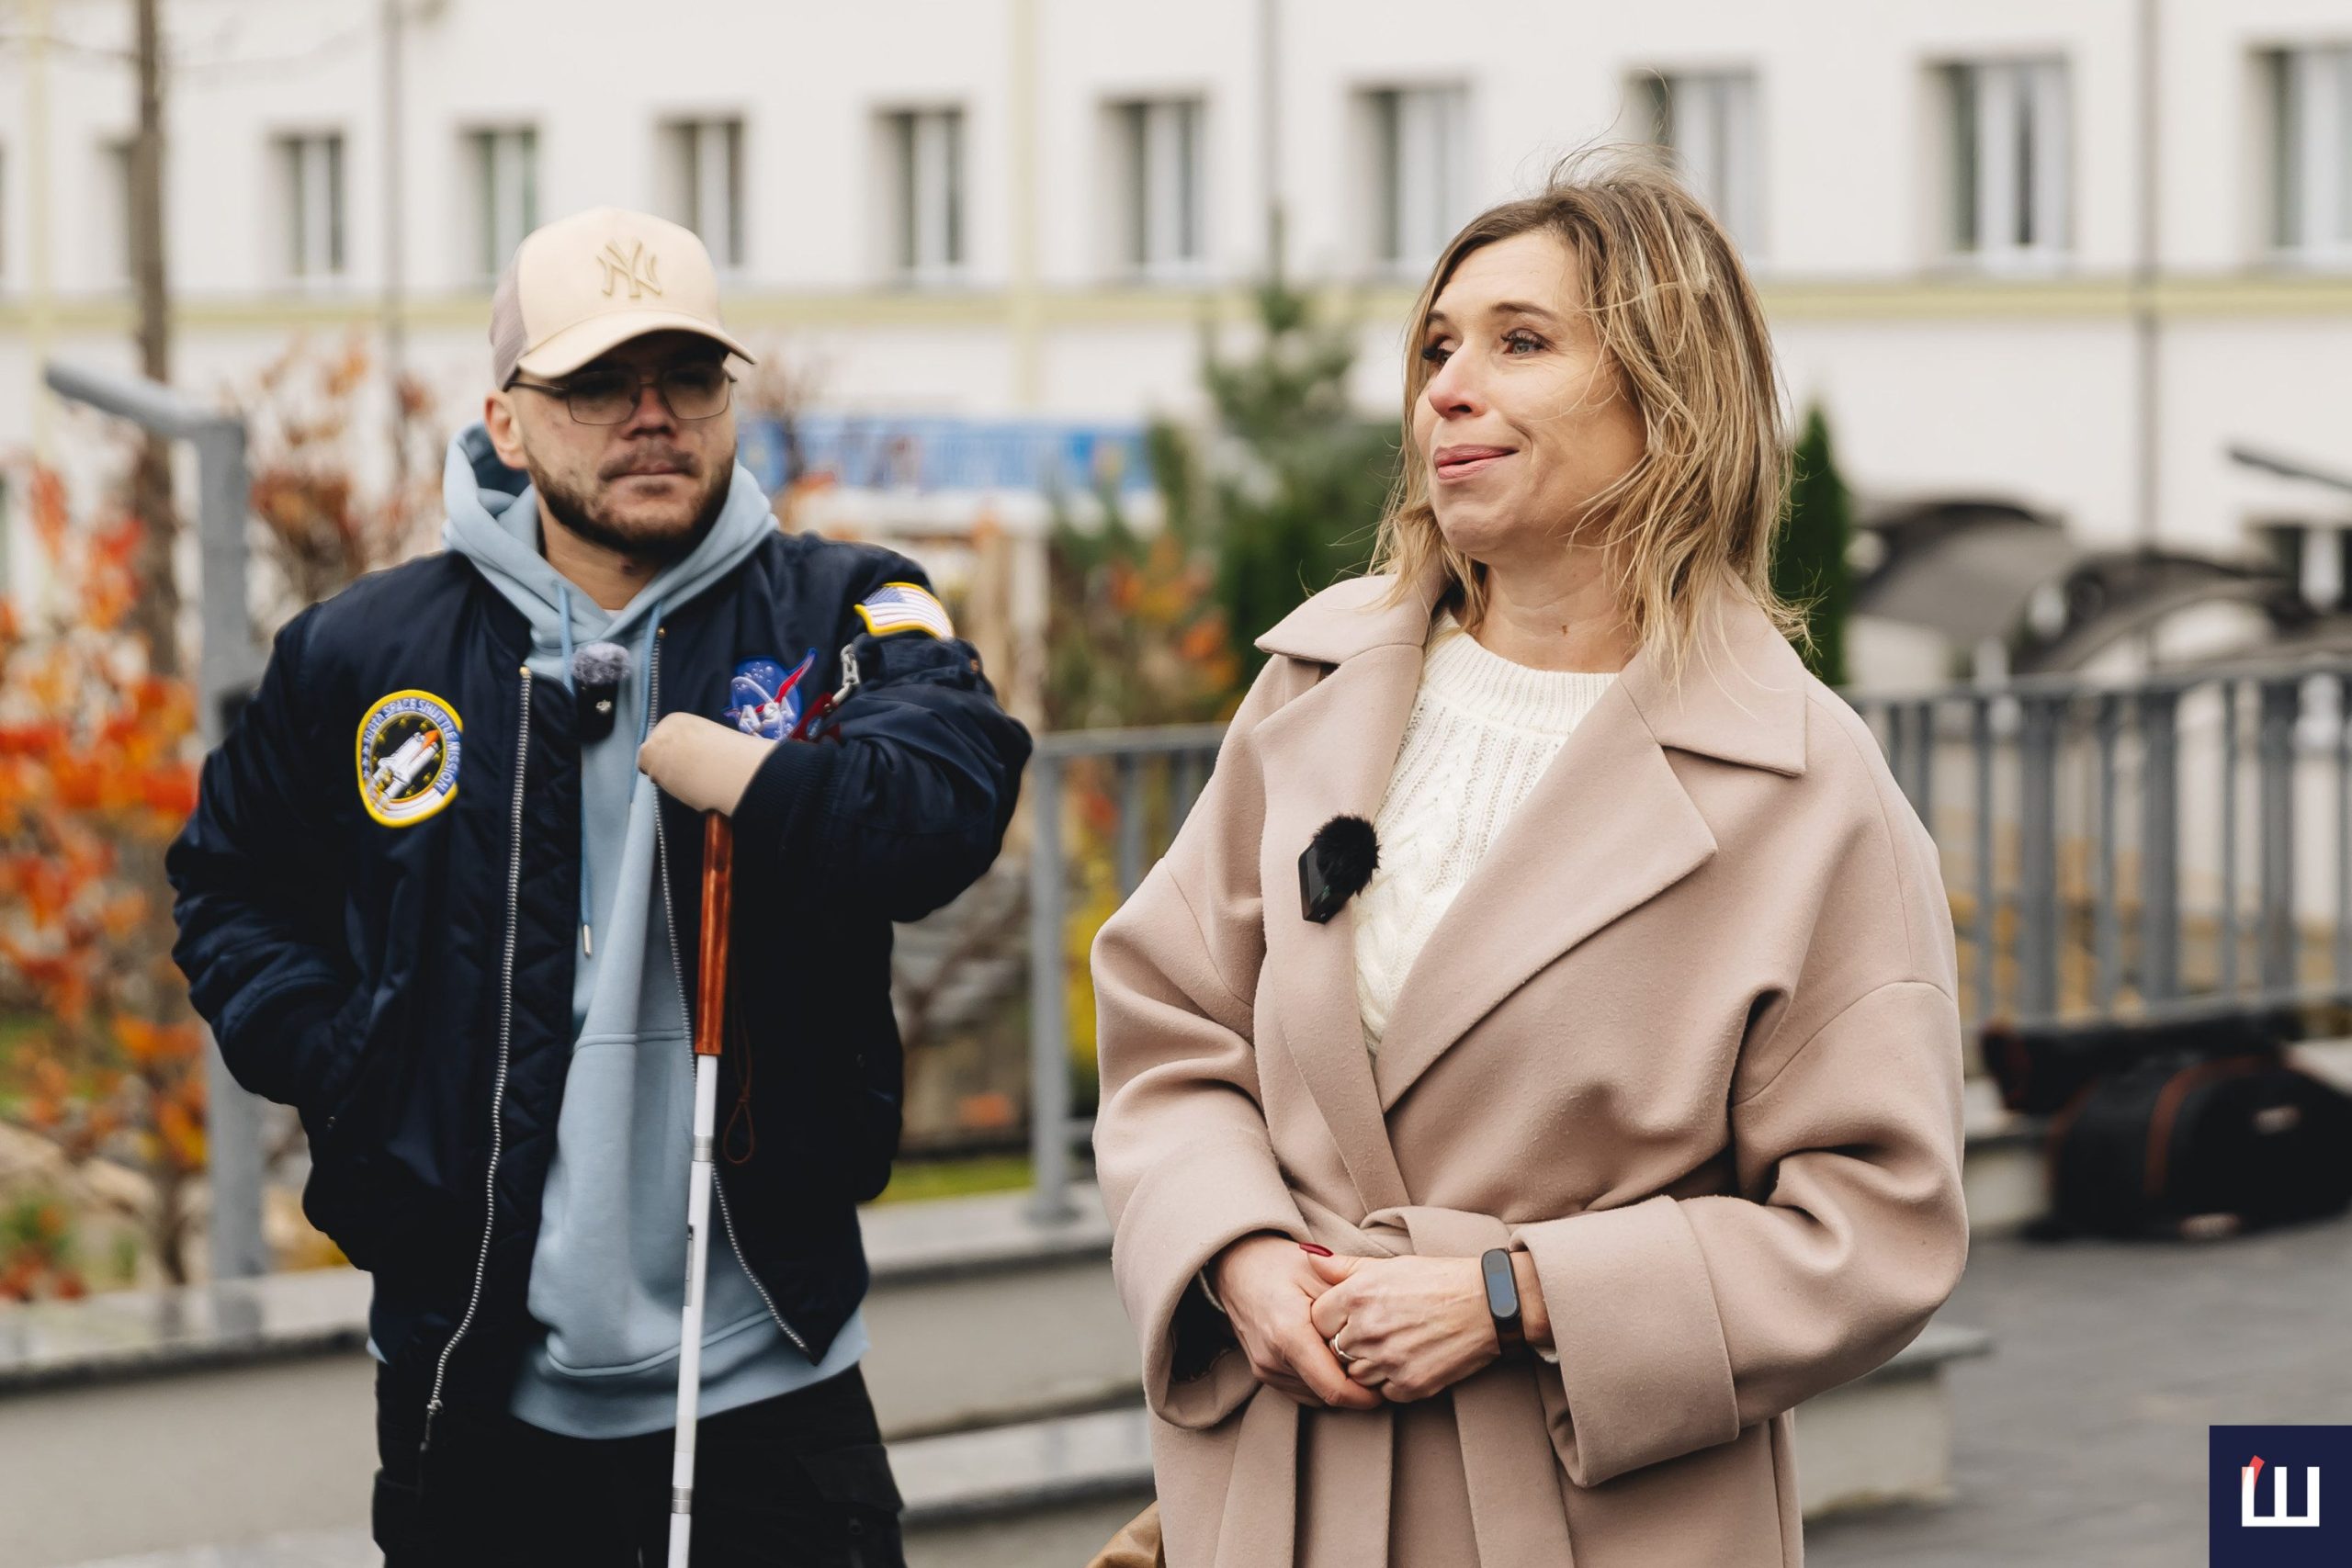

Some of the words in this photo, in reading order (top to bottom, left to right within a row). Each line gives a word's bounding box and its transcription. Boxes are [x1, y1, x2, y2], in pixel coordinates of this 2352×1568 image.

[595, 236, 663, 299] NY
[383, 698, 417, 718] SPACE
[416, 699, 459, 741] SHUTTLE
[738, 695, 796, 737] ASA
[435, 740, 461, 792] MISSION
